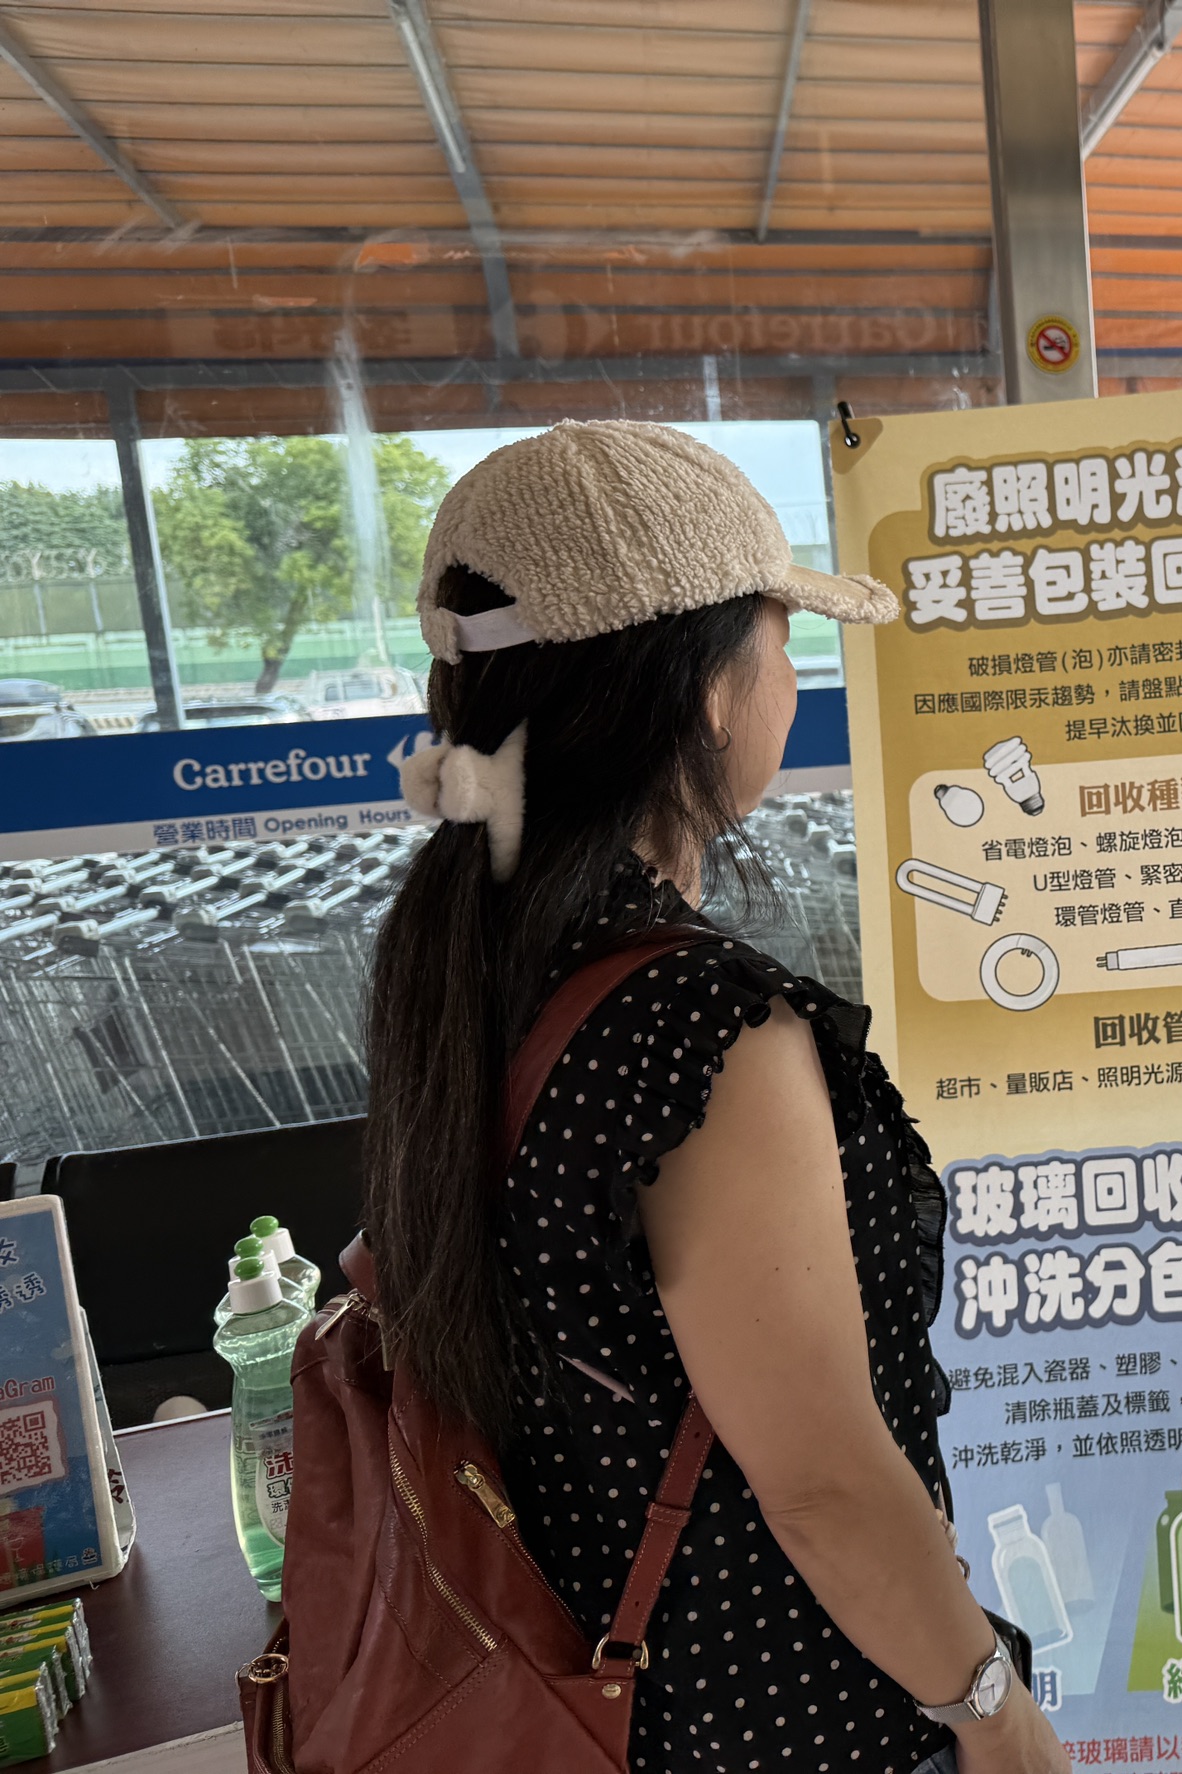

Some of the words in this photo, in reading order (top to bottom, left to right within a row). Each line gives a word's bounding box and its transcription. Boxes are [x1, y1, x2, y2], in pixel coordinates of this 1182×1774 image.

[172, 748, 371, 792] Carrefour
[153, 817, 257, 846] 營業時間
[264, 812, 349, 835] Opening
[359, 807, 411, 826] Hours
